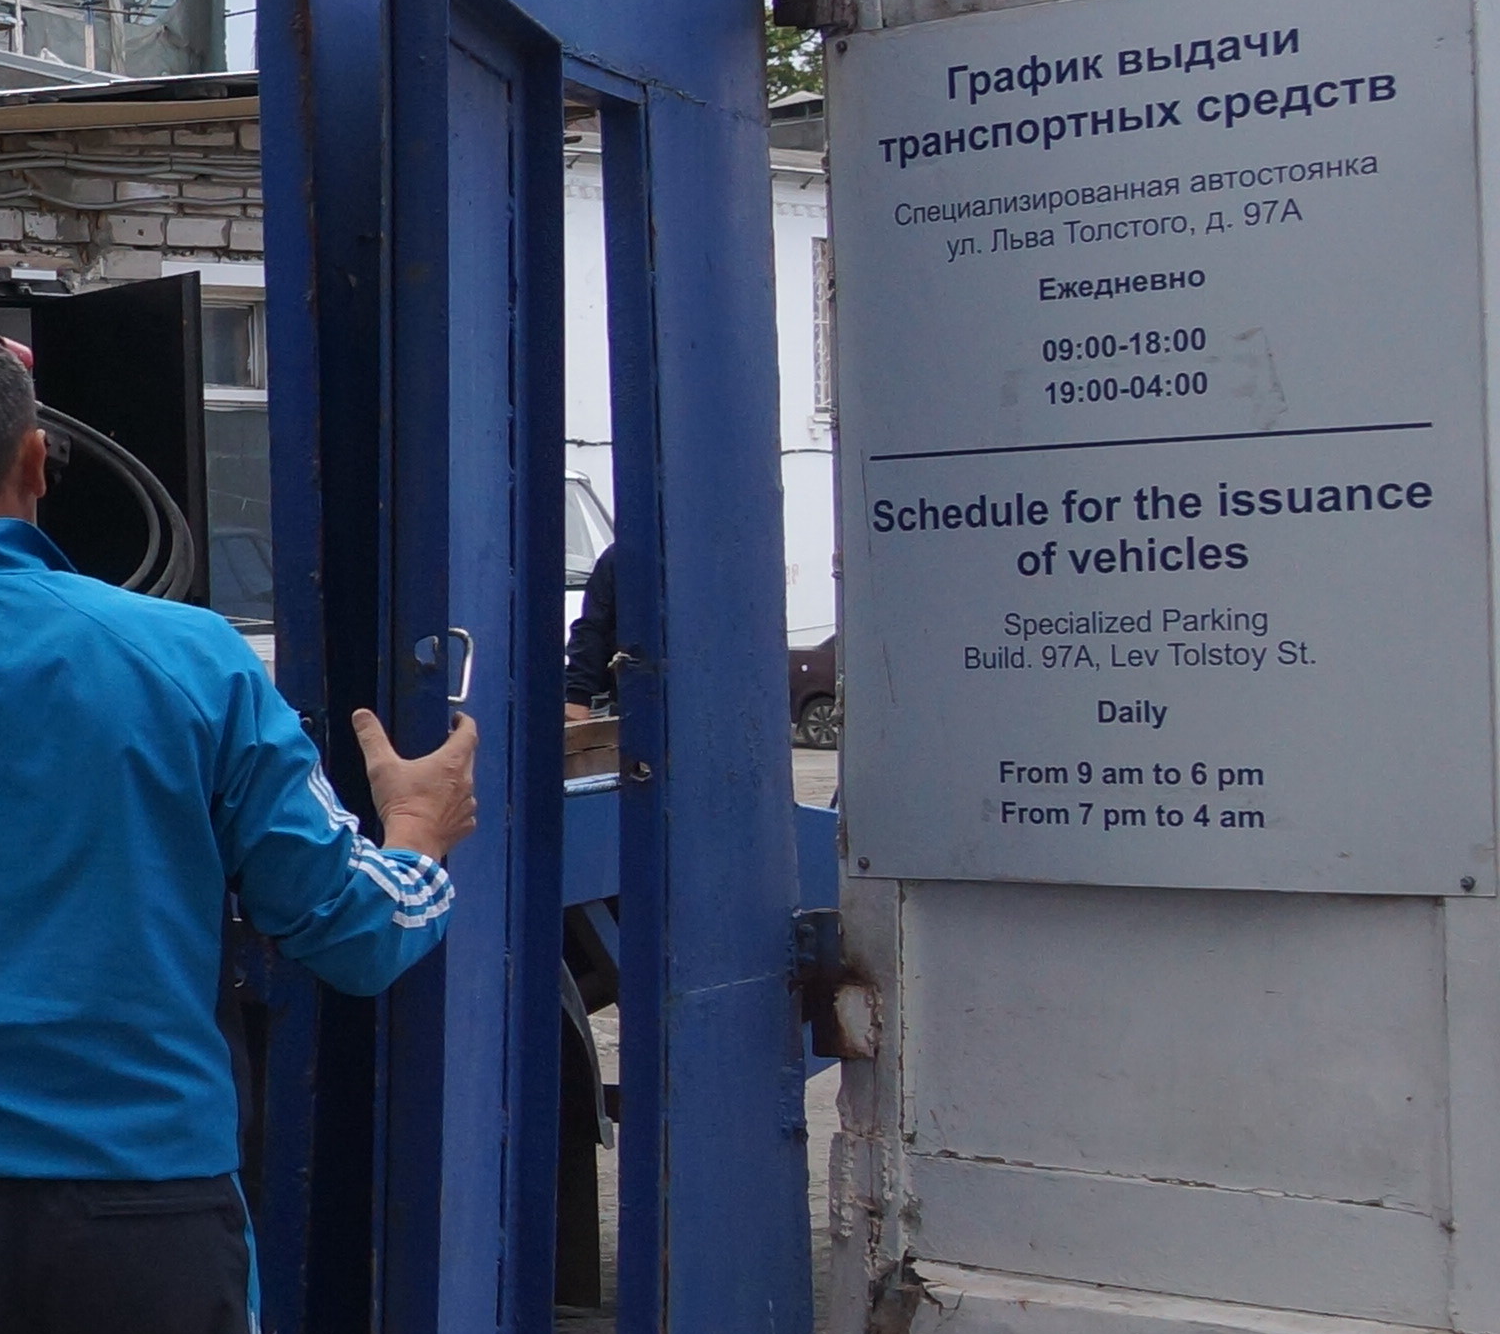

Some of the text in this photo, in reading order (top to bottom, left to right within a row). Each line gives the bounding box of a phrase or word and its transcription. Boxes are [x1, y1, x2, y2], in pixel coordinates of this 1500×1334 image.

[947, 27, 1300, 106] График выдачи
[878, 74, 1397, 170] транспортных средств
[894, 155, 1378, 227] Специализированная автостоянка
[946, 237, 982, 263] ул.
[990, 227, 1055, 253] Льва
[1062, 215, 1195, 244] Толстого,
[1205, 211, 1233, 235] д.
[1038, 269, 1206, 302] Ежедневно
[1042, 327, 1207, 363] 09:00-18:00
[1044, 371, 1208, 405] 19:00-04:00
[872, 481, 1433, 533] Schedule for the issuance
[1017, 535, 1249, 577] of vehicles
[1004, 607, 1268, 642] Specialized Parking
[964, 640, 1317, 672] Build. 97A, Lev Tolstoy St.
[1097, 699, 1168, 730] Daily
[999, 760, 1264, 792] From 9 am to 6 pm
[1001, 801, 1265, 832] From 7 pm to 4 am
